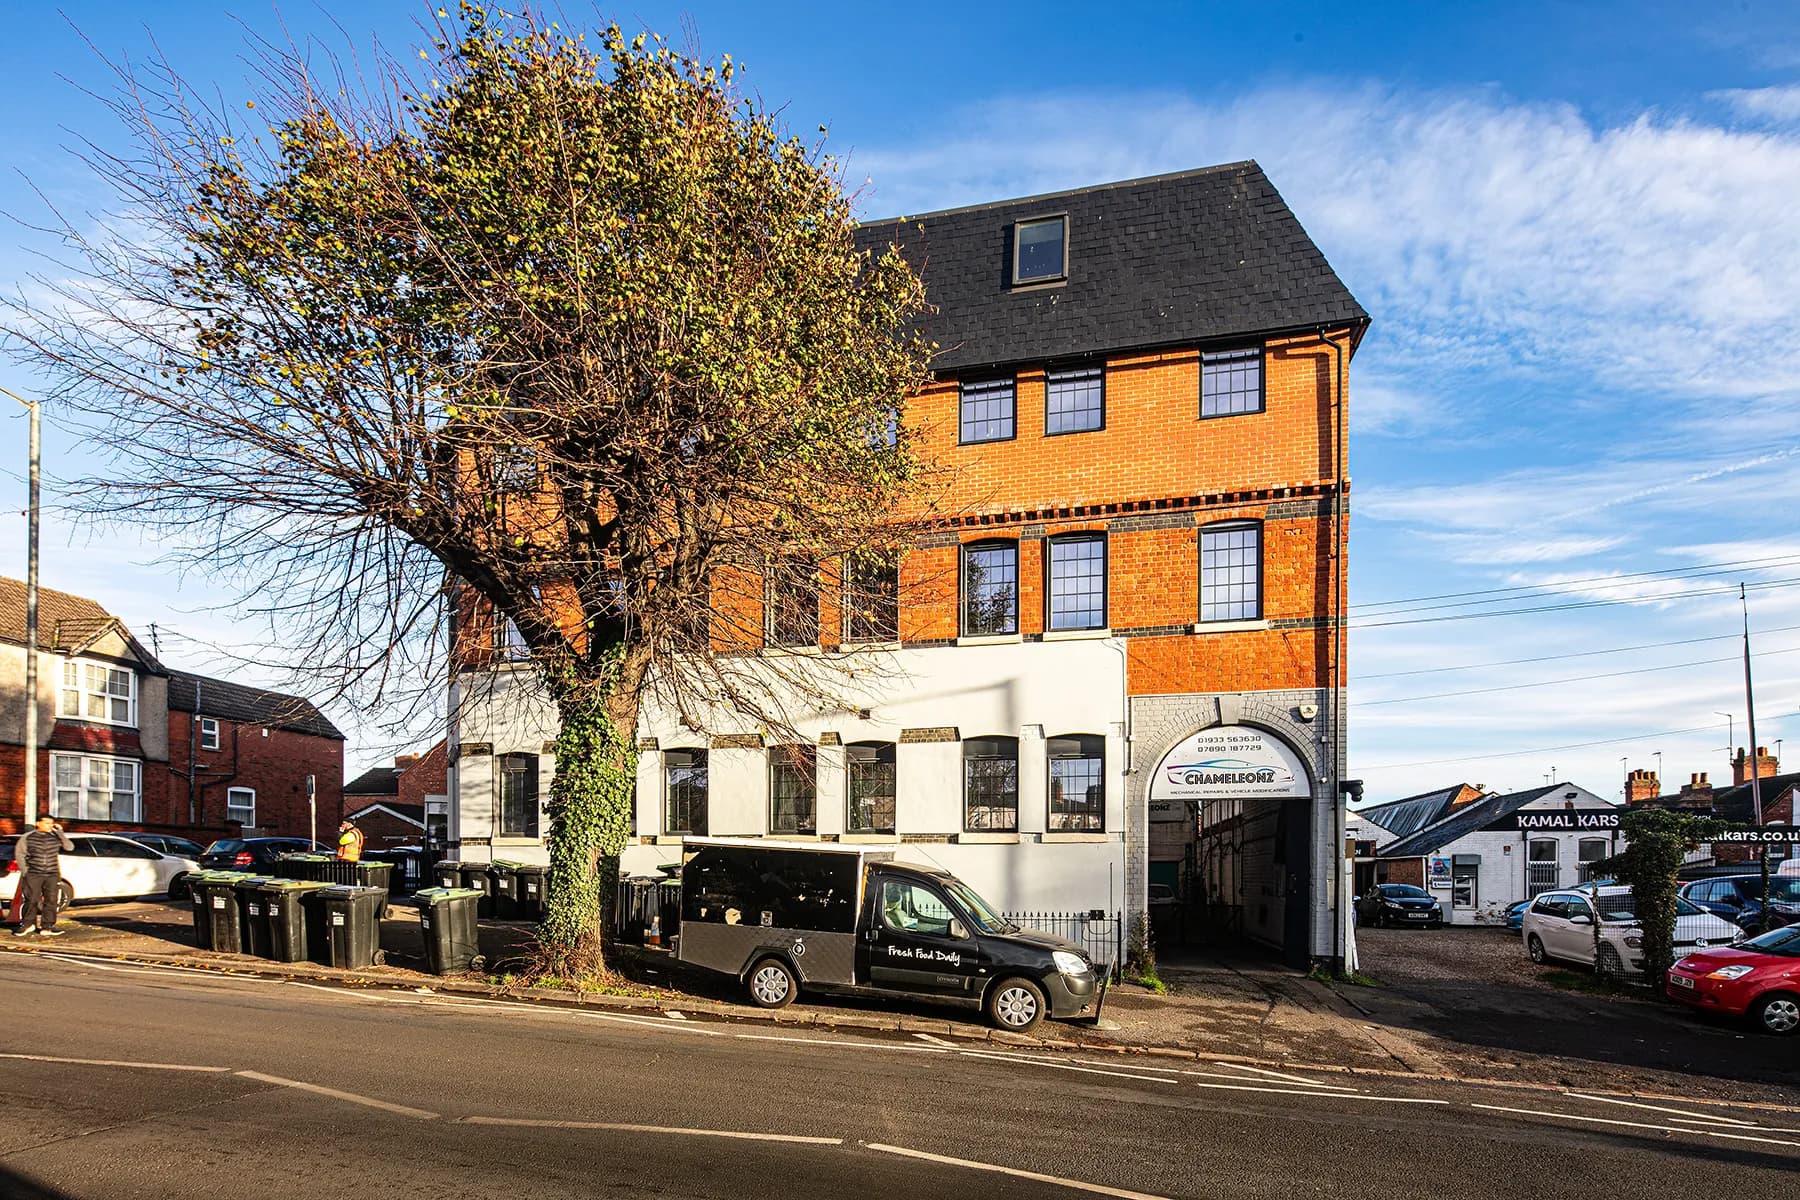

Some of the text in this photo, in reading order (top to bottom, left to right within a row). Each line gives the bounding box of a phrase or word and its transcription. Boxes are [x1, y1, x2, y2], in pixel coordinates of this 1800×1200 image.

[1227, 735, 1262, 743] 563630
[1197, 744, 1262, 753] 07890 187729
[1184, 773, 1274, 785] CHAMELEONZ
[1517, 814, 1619, 828] KAMAL KARS
[888, 945, 961, 967] Fresh Food Daily
